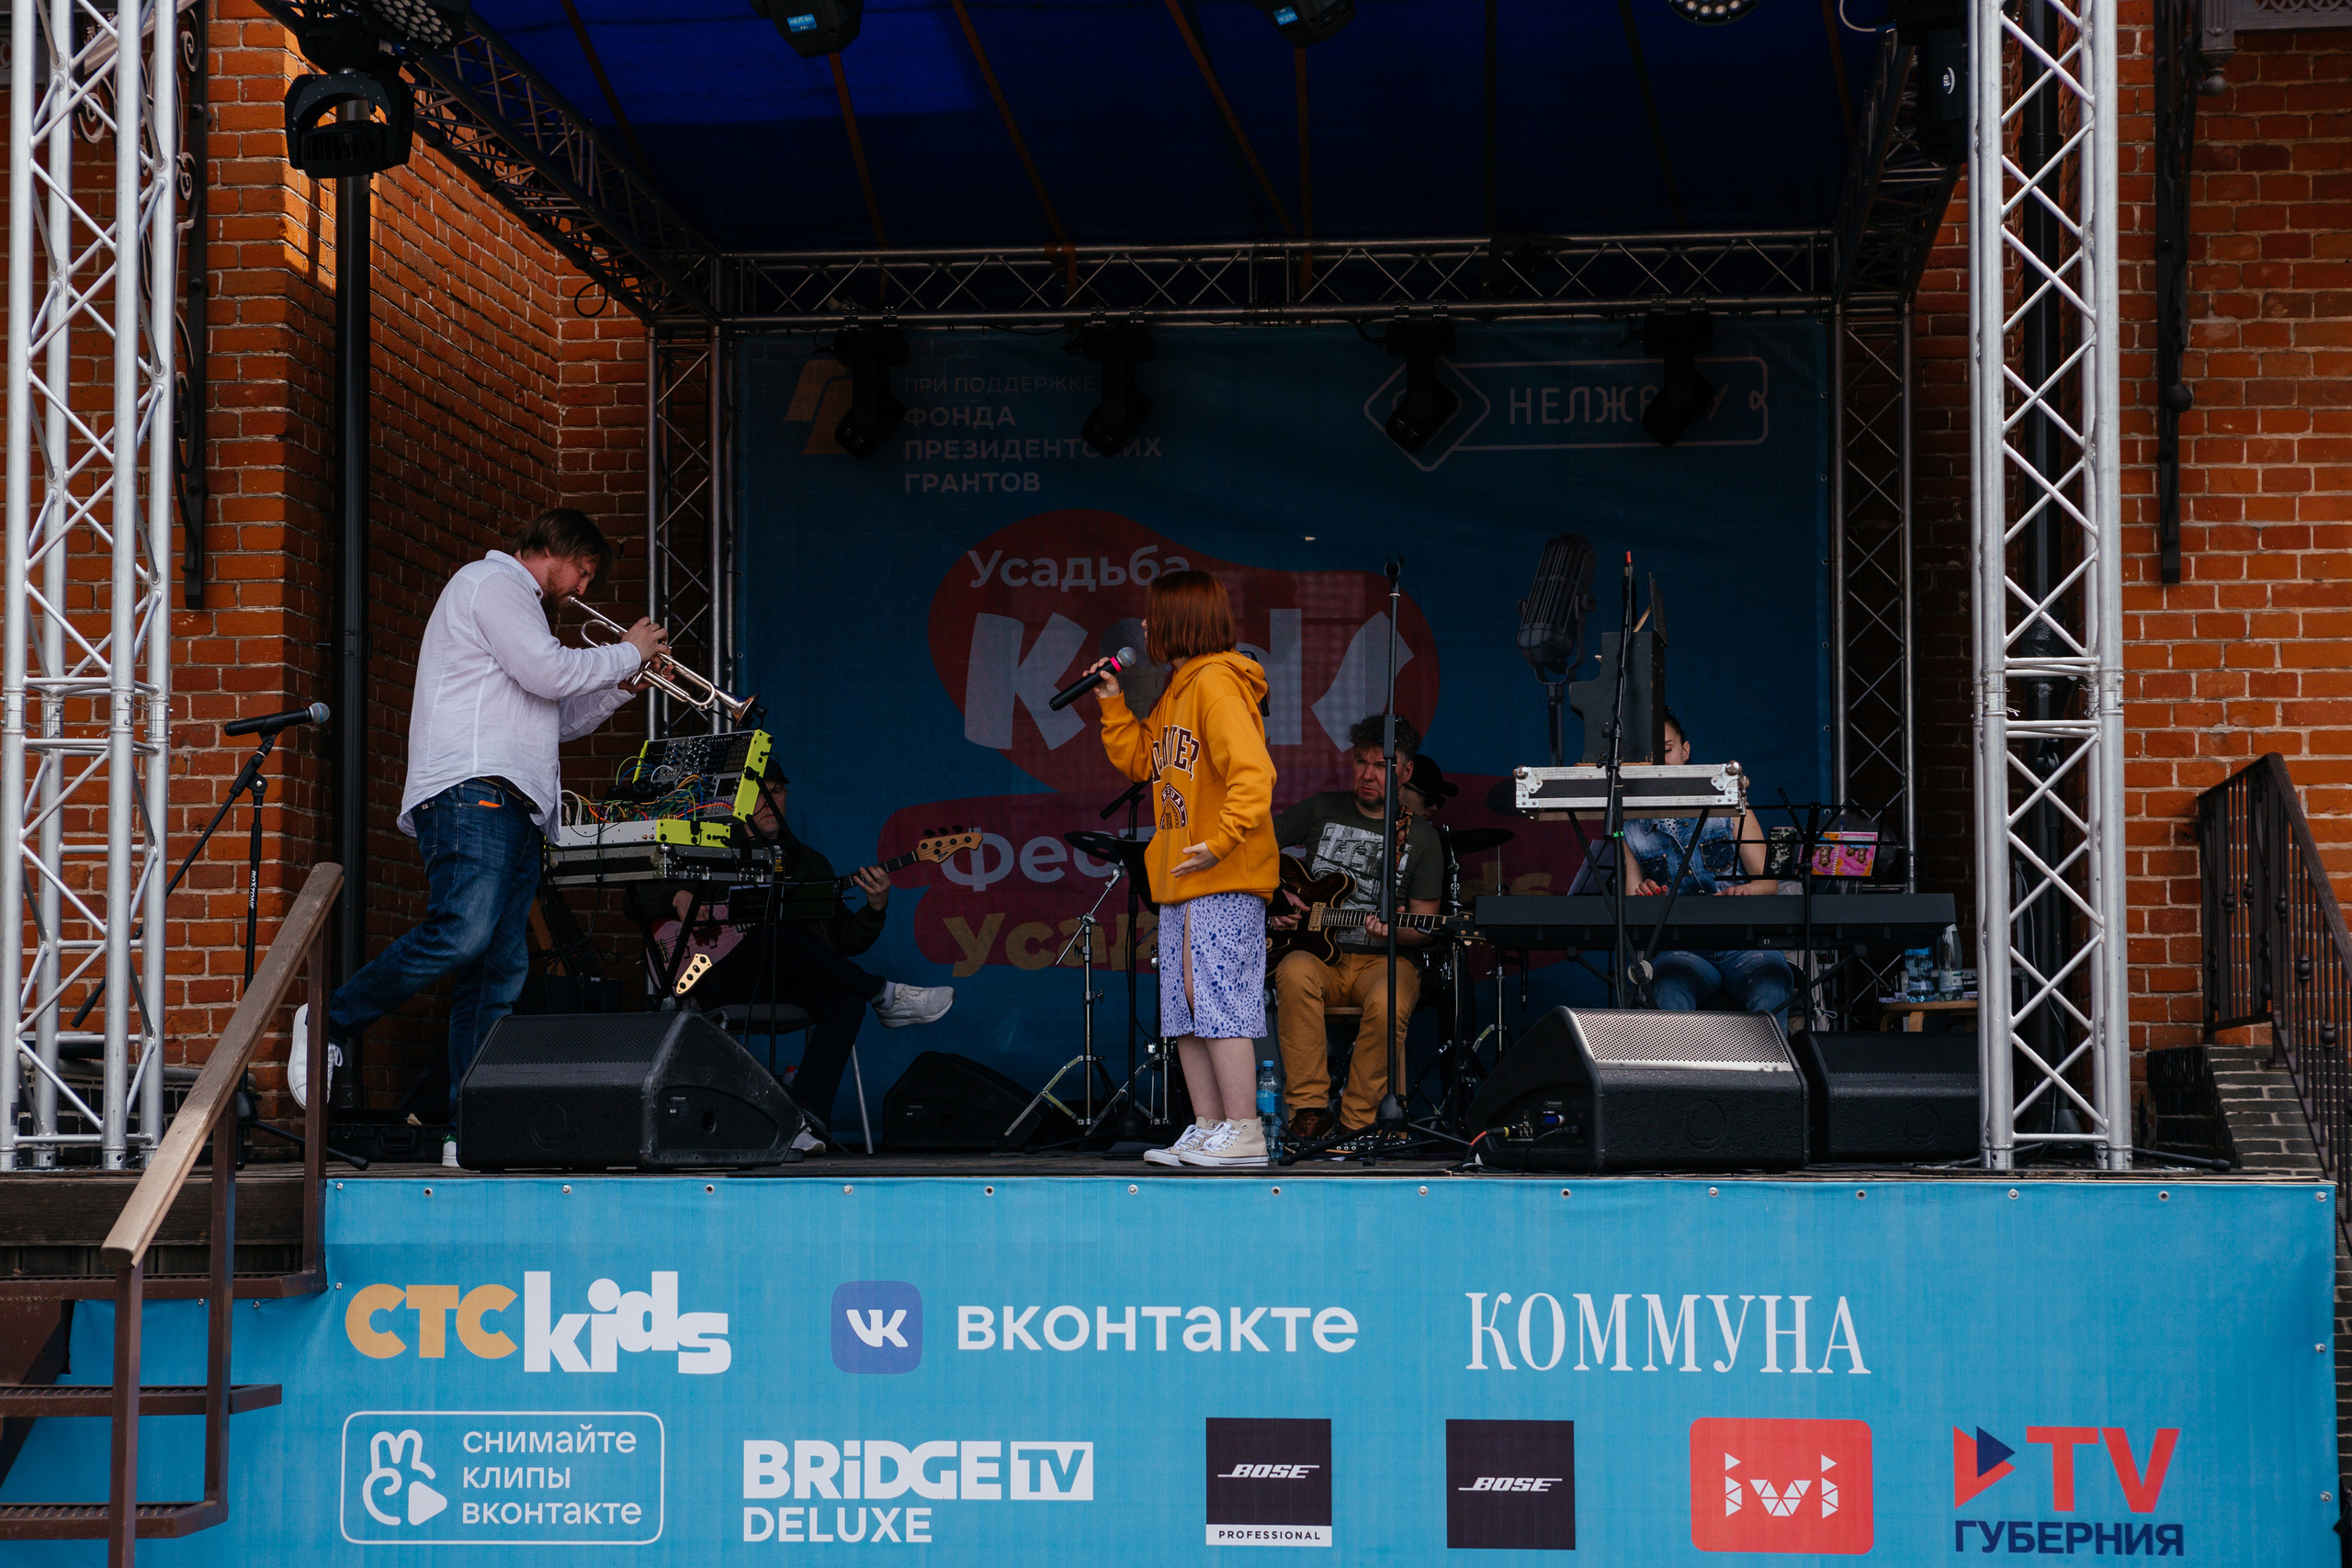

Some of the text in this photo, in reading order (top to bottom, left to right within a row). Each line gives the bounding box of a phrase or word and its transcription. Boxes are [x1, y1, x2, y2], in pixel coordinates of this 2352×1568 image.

[904, 375, 1095, 397] ПРИ ПОДДЕРЖКЕ
[905, 405, 1016, 430] ФОНДА
[904, 436, 1163, 462] ПРЕЗИДЕНТСИХ
[904, 471, 1042, 494] ГРАНТОВ
[249, 869, 257, 909] ROXTONE
[1464, 1292, 1872, 1375] КОММУНА
[462, 1422, 638, 1455] снимайте
[462, 1467, 571, 1490] клипы
[1018, 1447, 1089, 1494] TV
[1217, 1463, 1320, 1480] BOSE
[2025, 1427, 2181, 1514] TV
[1458, 1477, 1563, 1494] BOSE
[462, 1502, 643, 1526] вконтакте
[743, 1506, 933, 1544] DELUXE
[1218, 1529, 1321, 1541] PROFESSIONAL
[1955, 1520, 2185, 1558] ГУБЕРНИЯ
